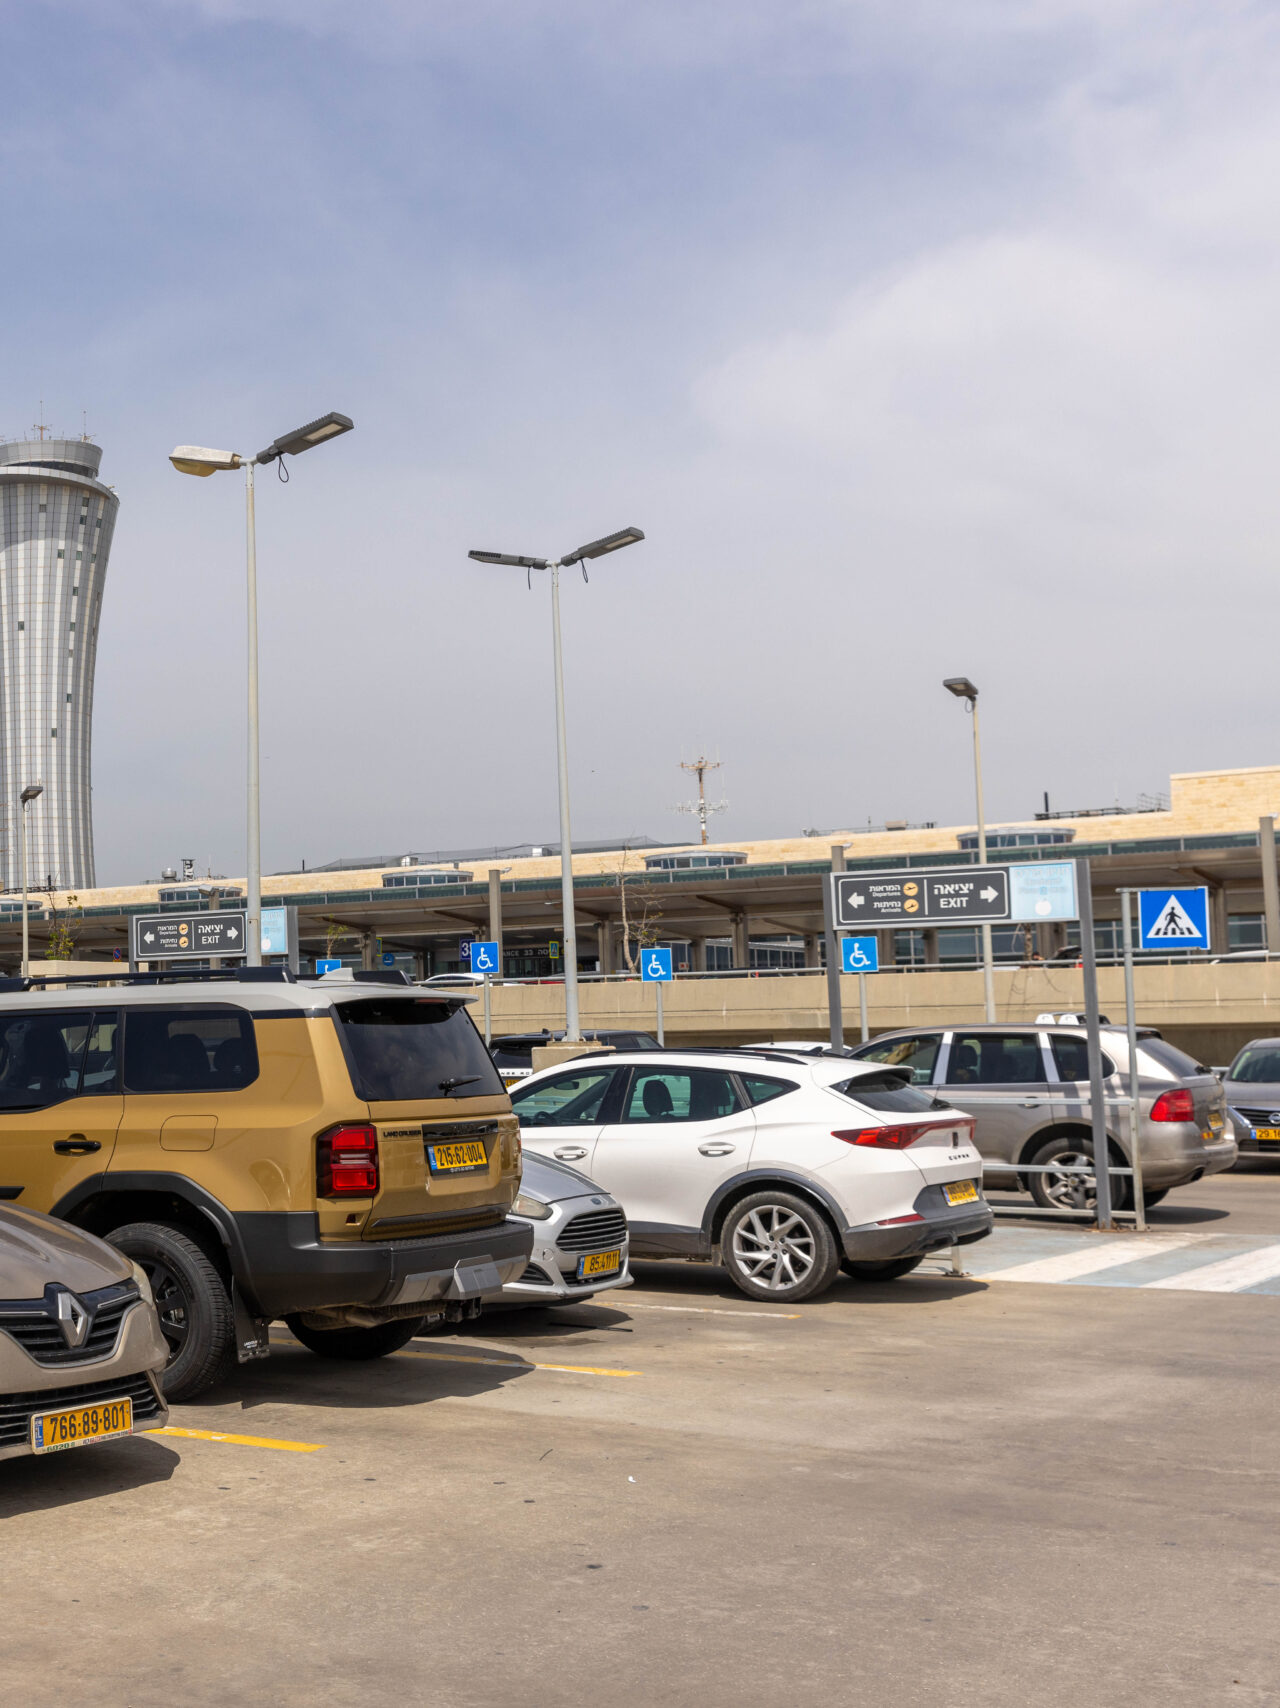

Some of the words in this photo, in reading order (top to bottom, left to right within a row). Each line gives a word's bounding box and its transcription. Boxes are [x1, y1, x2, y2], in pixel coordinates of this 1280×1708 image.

[934, 883, 973, 895] יציאה
[940, 897, 969, 909] EXIT
[198, 924, 223, 934] יציאה
[201, 935, 220, 945] EXIT
[461, 942, 472, 957] 3
